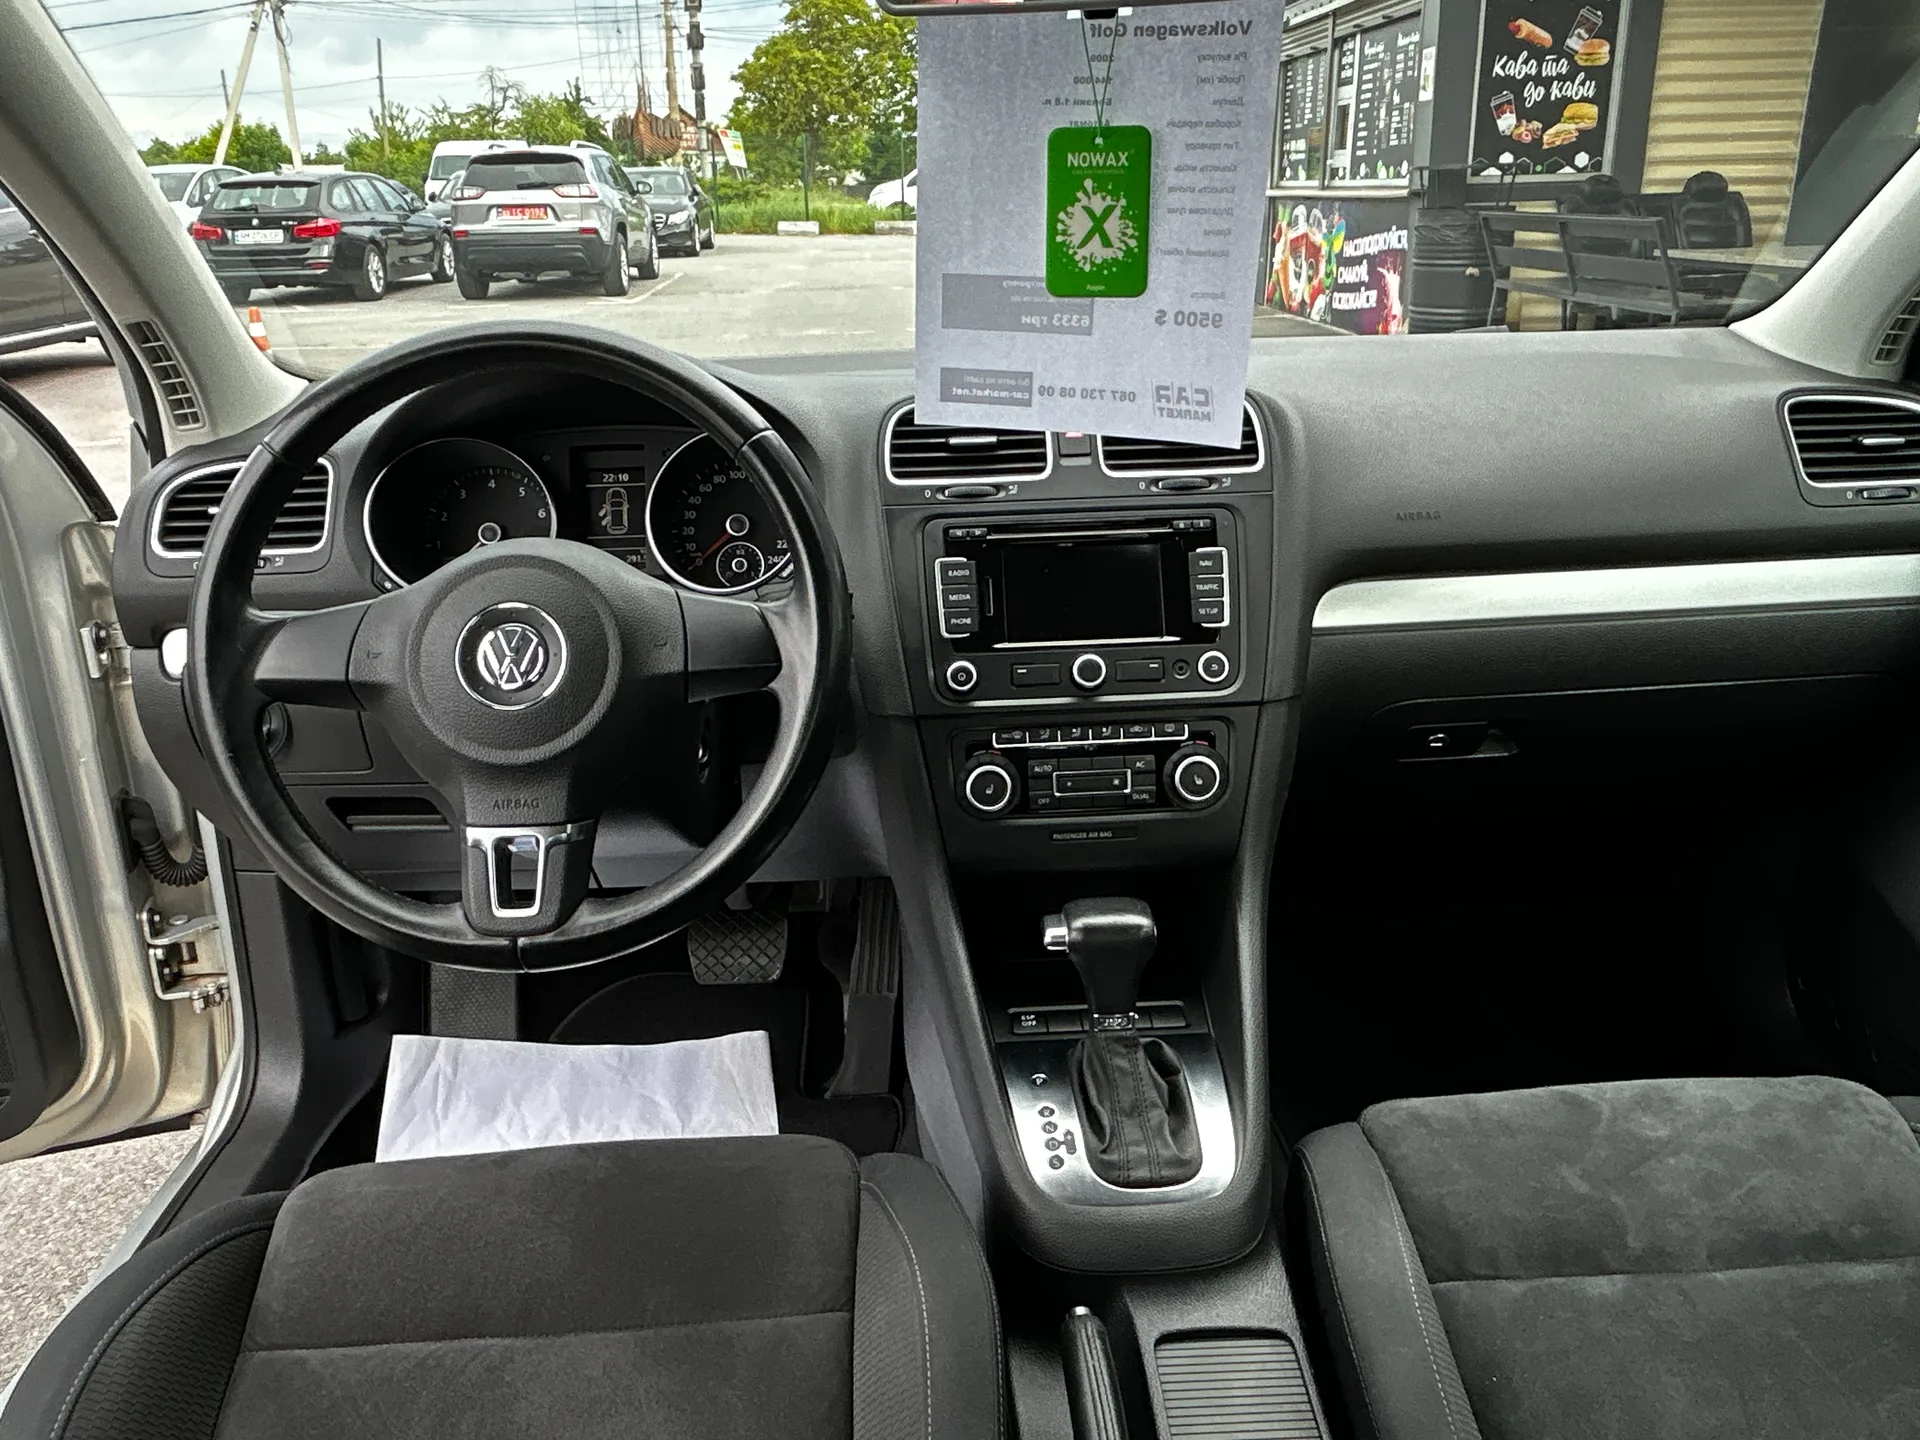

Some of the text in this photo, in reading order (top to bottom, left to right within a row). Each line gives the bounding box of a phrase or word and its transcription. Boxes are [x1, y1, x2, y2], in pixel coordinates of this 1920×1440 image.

[1492, 50, 1570, 79] Кава та
[1523, 72, 1597, 108] до кави
[1067, 152, 1129, 167] NOWAX
[488, 479, 496, 489] 4
[518, 486, 525, 497] 5
[688, 495, 702, 504] 40
[537, 508, 546, 519] 6
[683, 510, 696, 519] 30
[682, 526, 695, 535] 20
[685, 542, 696, 551] 10
[948, 569, 969, 577] RADIO
[948, 593, 971, 601] MEDIA
[950, 617, 972, 625] PHONE
[493, 798, 540, 811] AIRBAG
